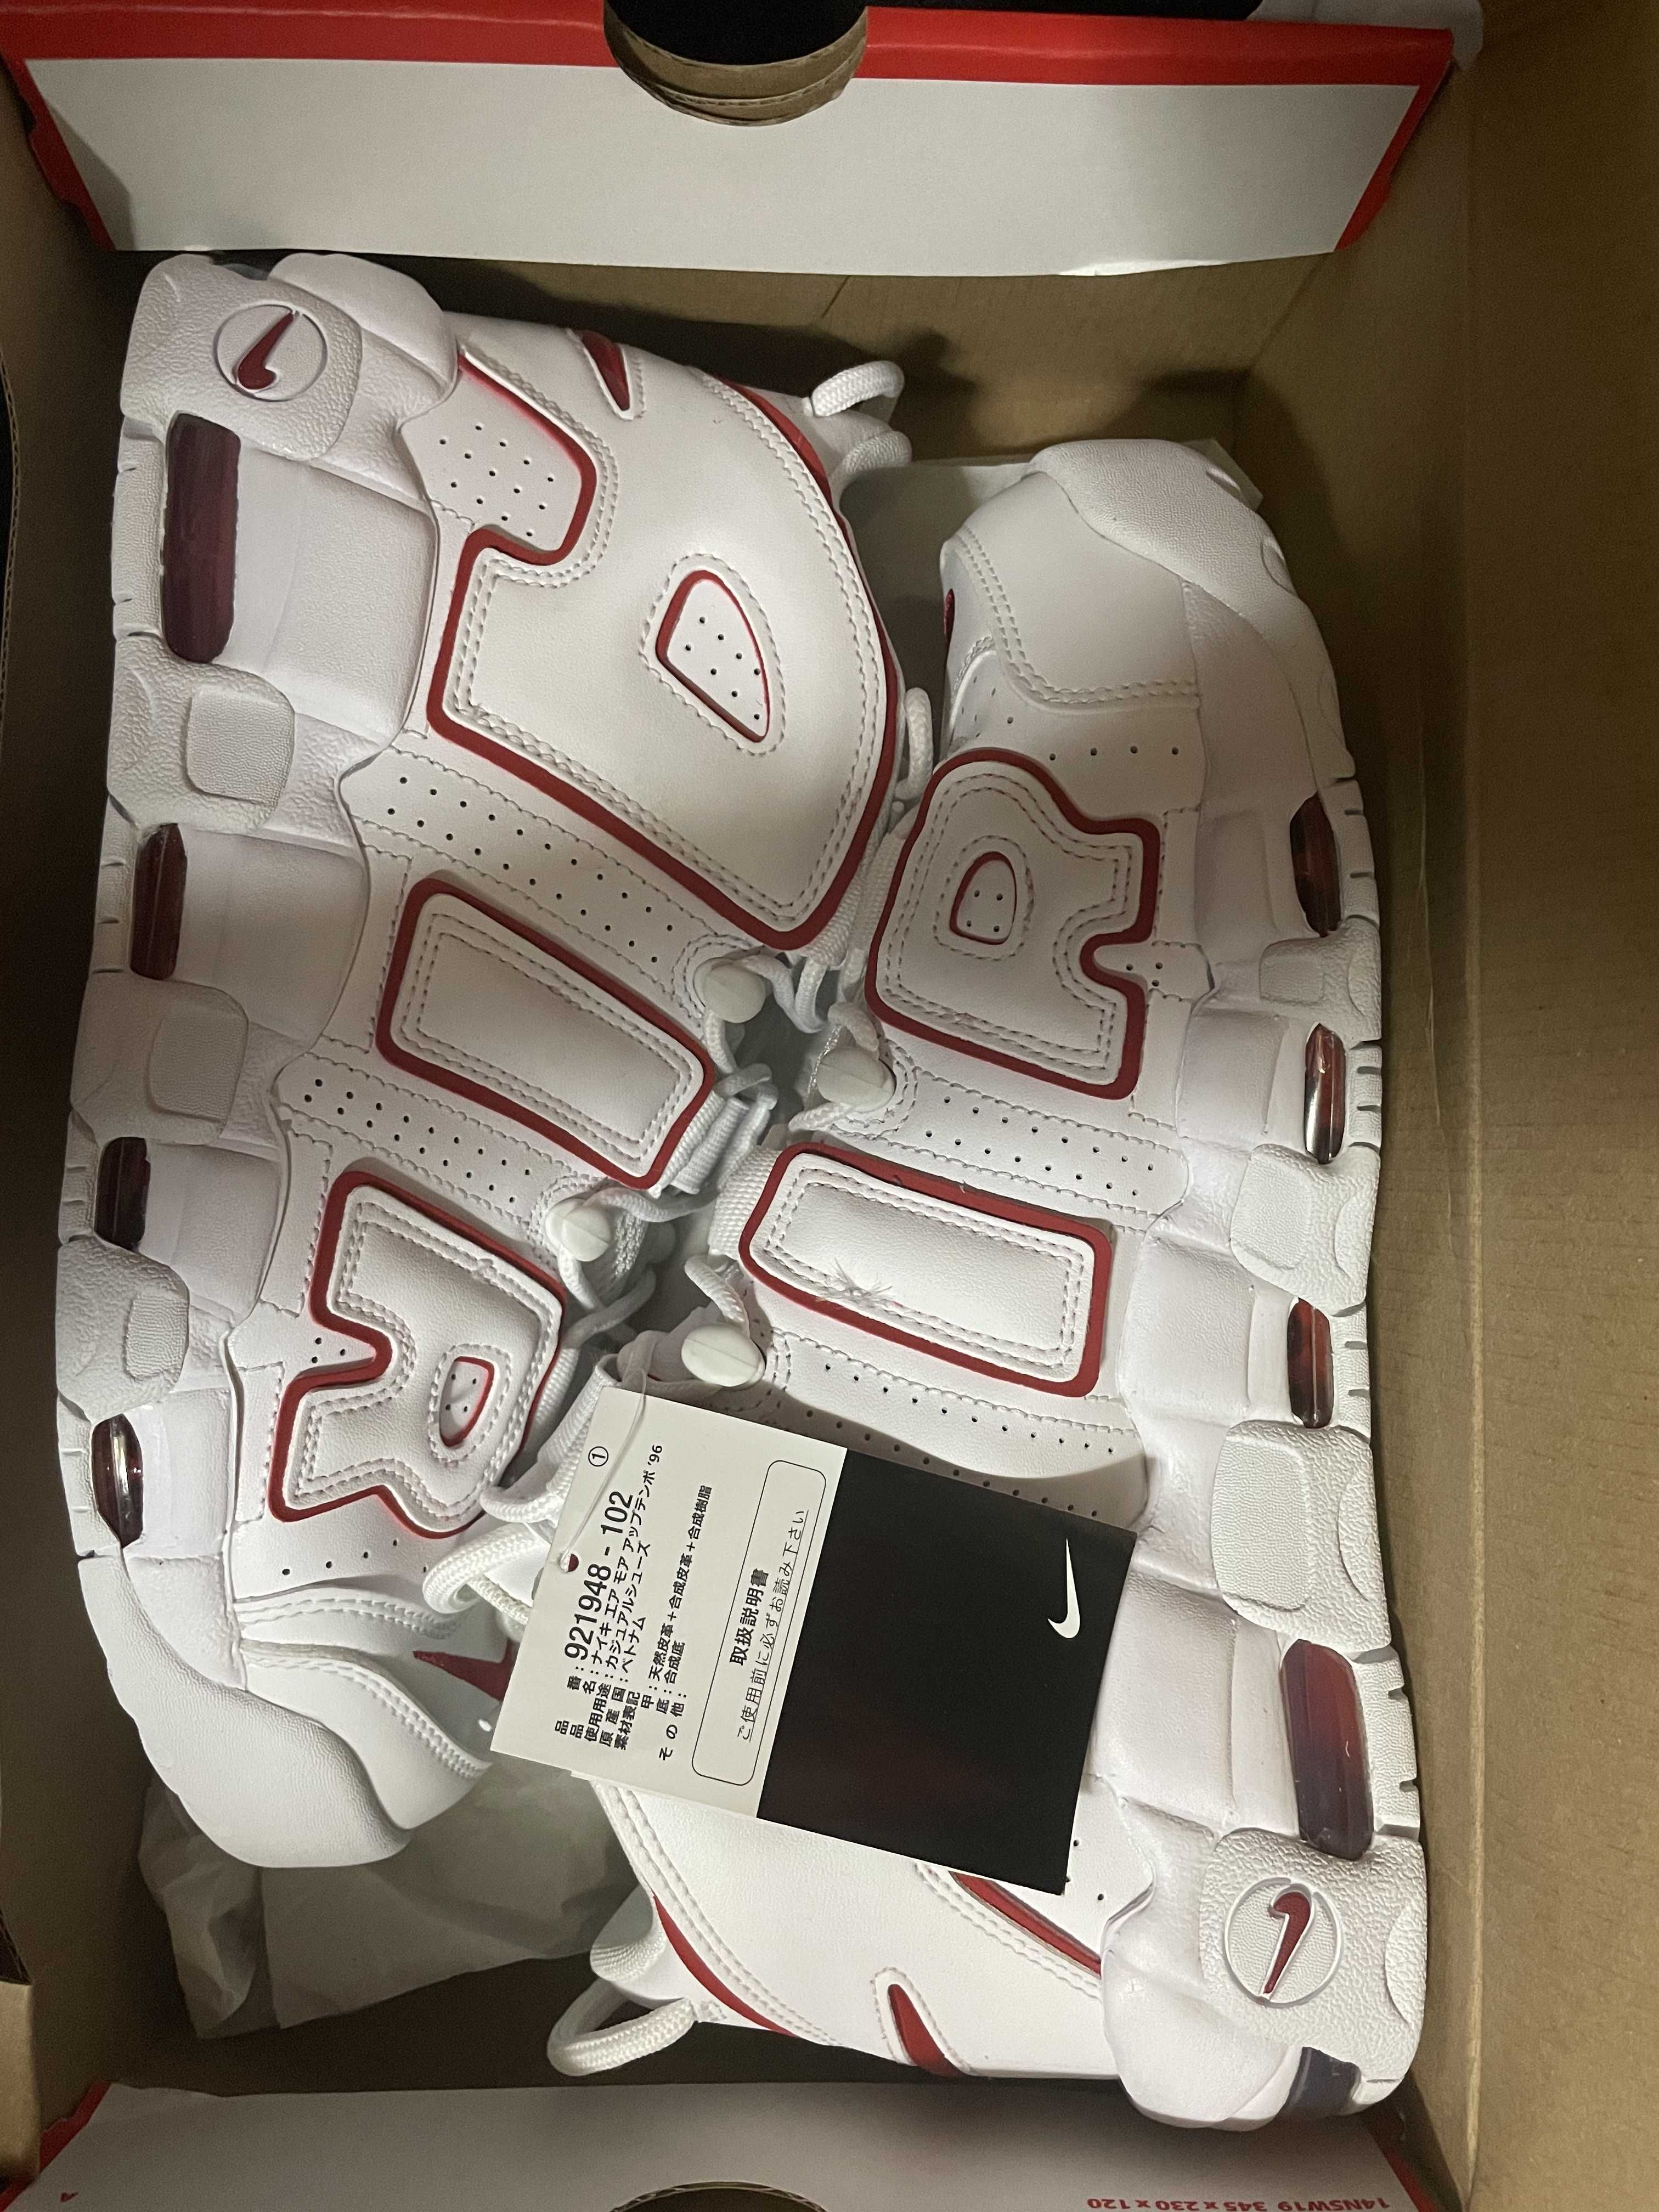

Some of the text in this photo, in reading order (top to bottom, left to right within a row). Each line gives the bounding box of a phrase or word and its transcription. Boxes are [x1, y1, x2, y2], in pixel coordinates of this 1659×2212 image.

[564, 1564, 611, 1660] 921948
[600, 1491, 633, 1534] 102
[591, 1622, 612, 1664] ナイキ
[604, 1588, 619, 1618] エア
[613, 1555, 628, 1584] モア
[622, 1470, 655, 1552] アップテンポ
[729, 1568, 769, 1666] 取扱説明書
[737, 1509, 809, 1742] ご使用前に必ずお読み下さい
[613, 1690, 640, 1750] 素材表記
[1087, 2198, 1131, 2209] 120
[1155, 2200, 1200, 2211] 230
[1223, 2201, 1267, 2211] 345
[1278, 2197, 1390, 2211] 14NSW19
